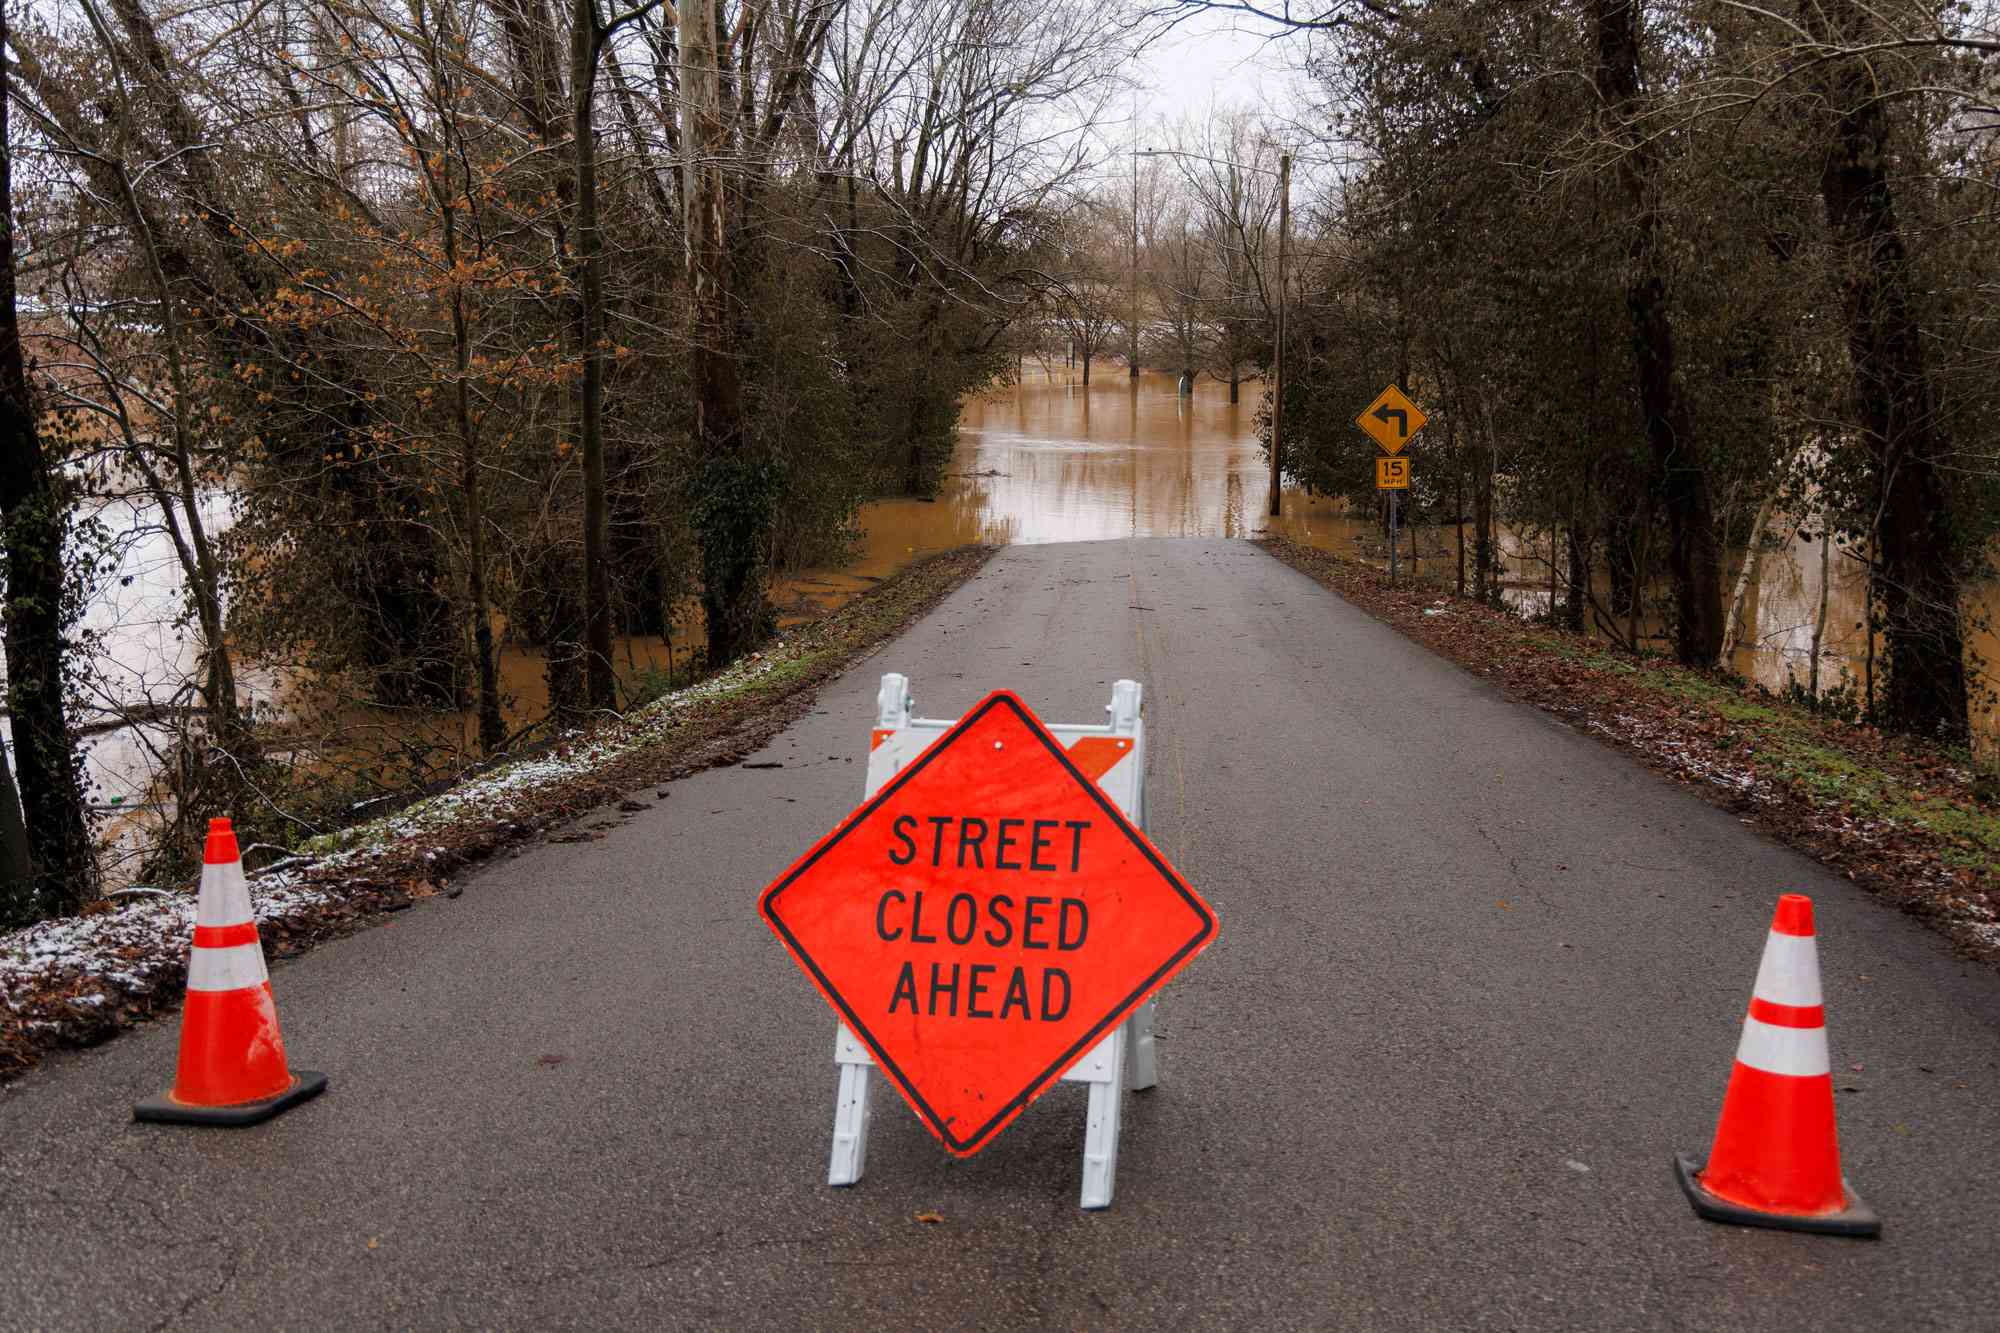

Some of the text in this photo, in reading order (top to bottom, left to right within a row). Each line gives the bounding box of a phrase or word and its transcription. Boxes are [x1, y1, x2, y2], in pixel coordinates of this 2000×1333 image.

[1383, 461, 1403, 476] 15
[889, 815, 1091, 872] STREET
[876, 889, 1089, 951] CLOSED
[888, 961, 1072, 1022] AHEAD
